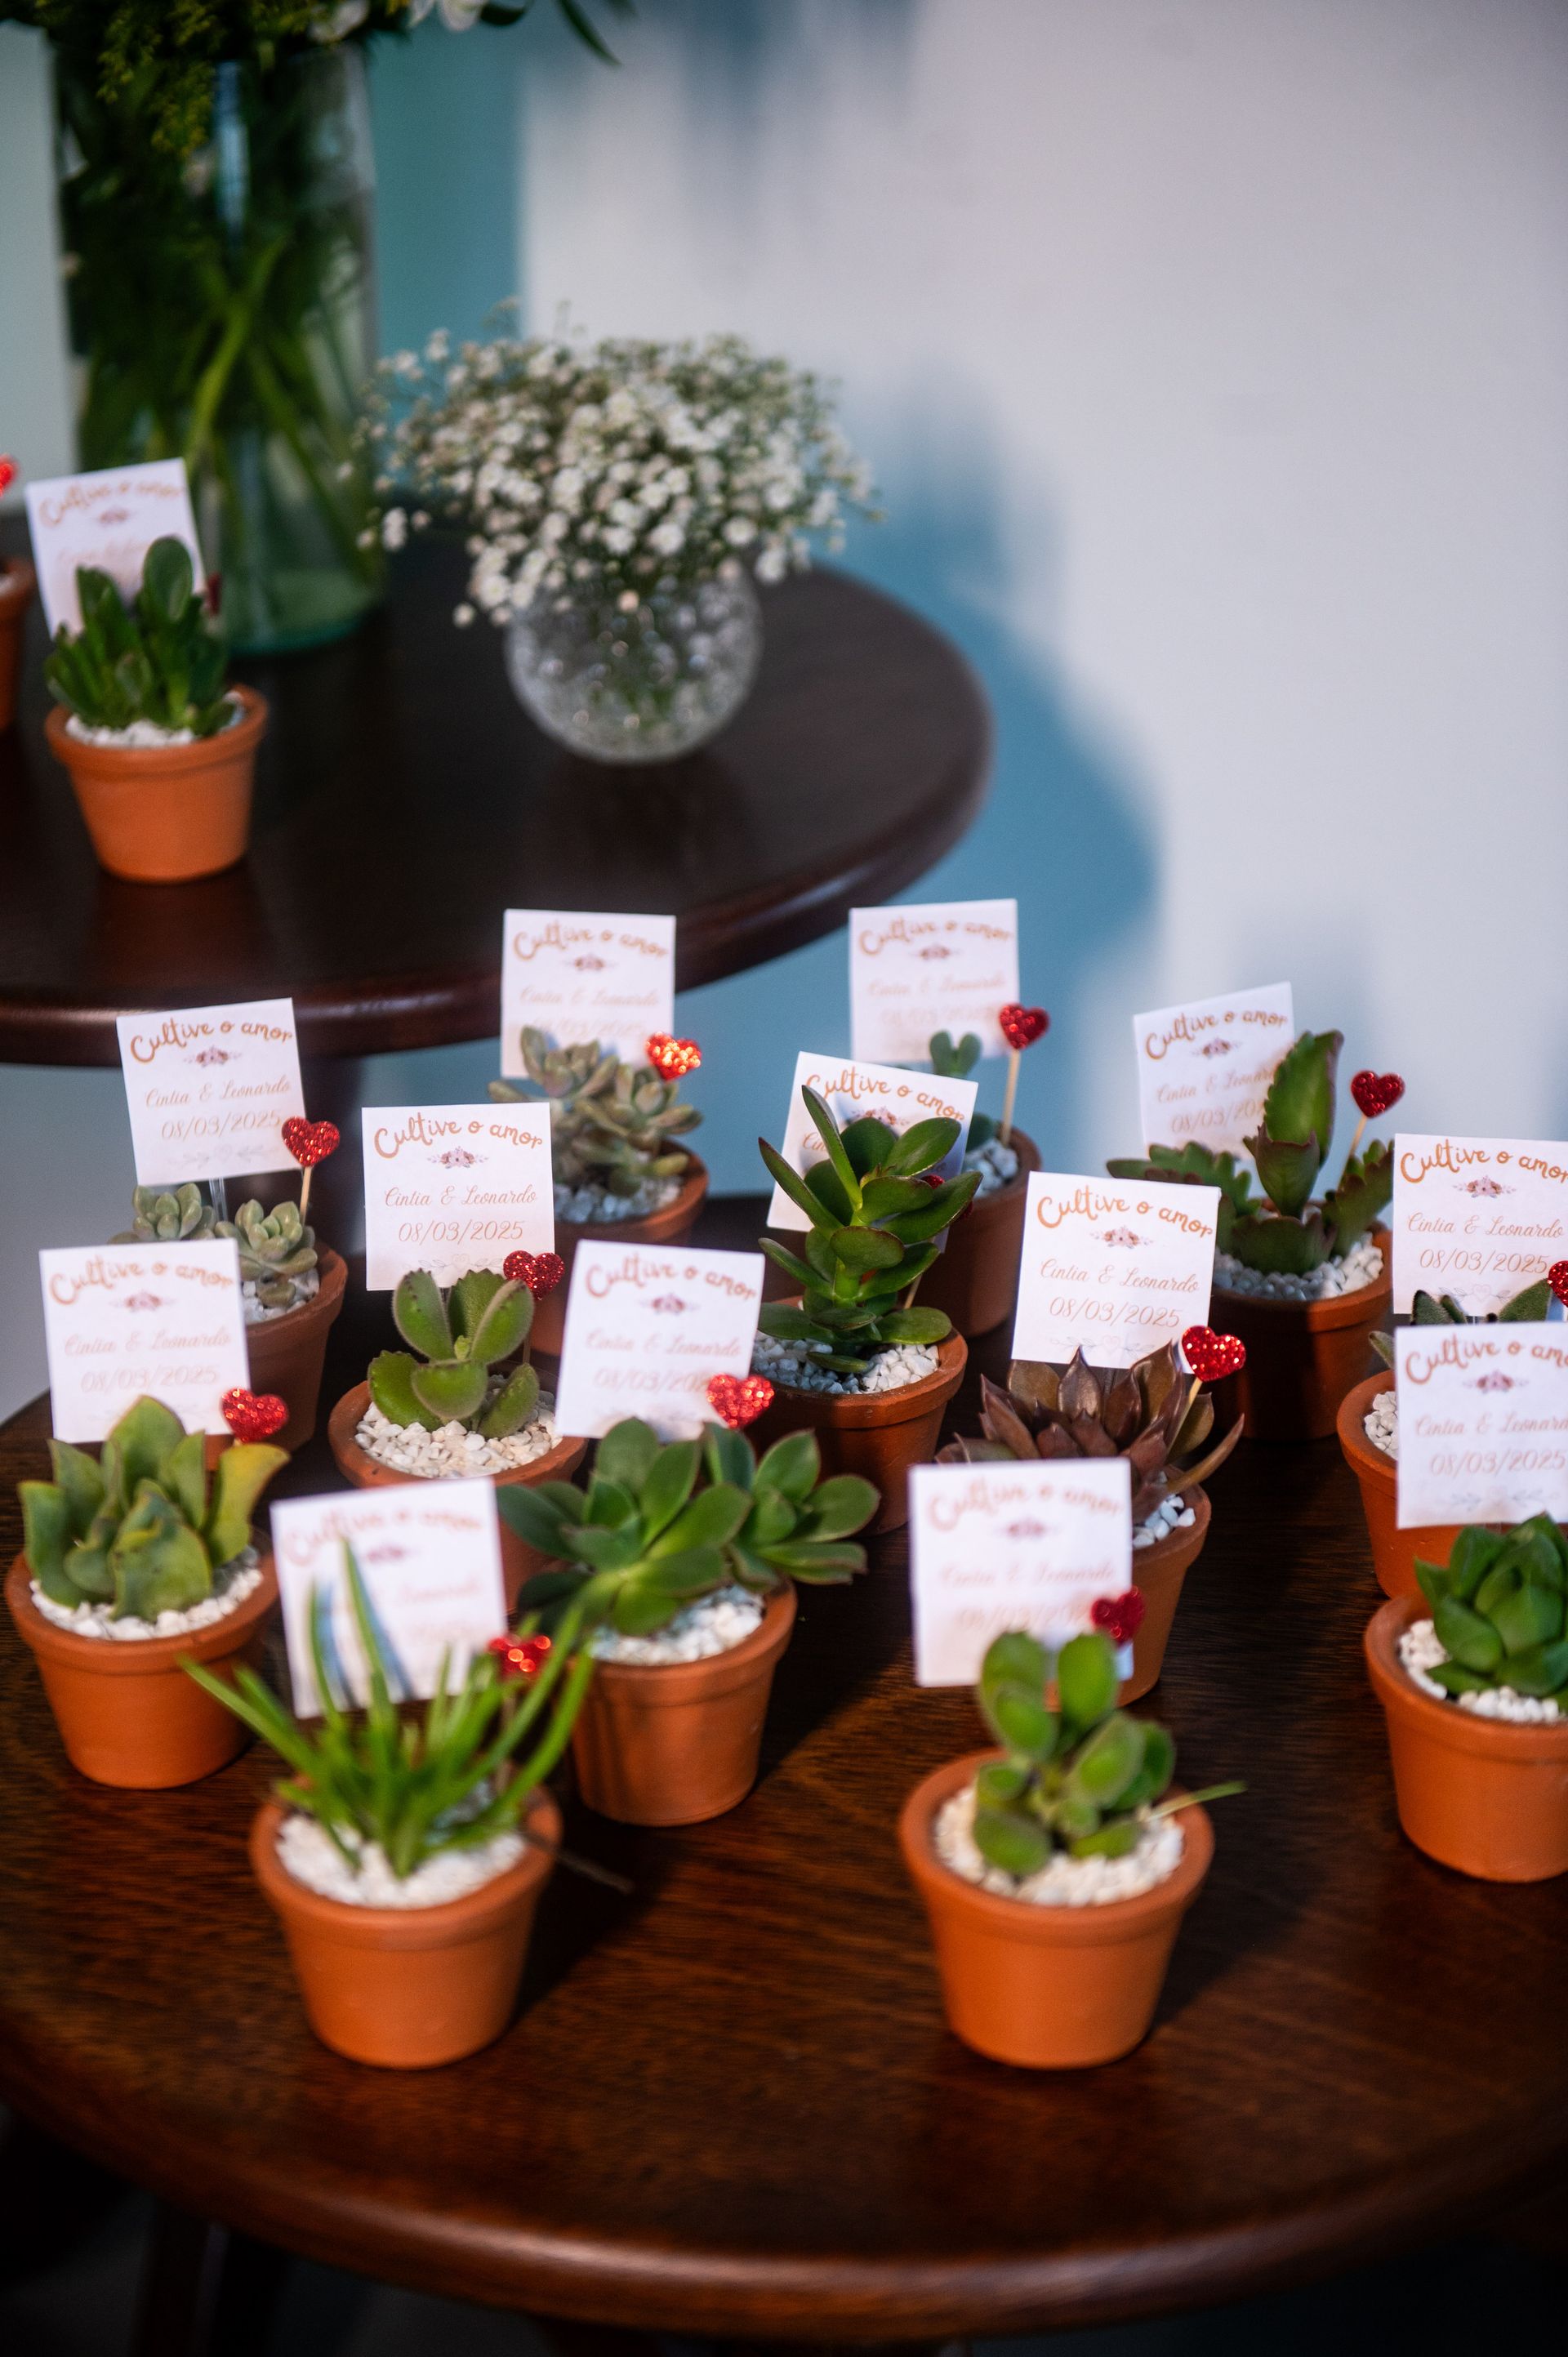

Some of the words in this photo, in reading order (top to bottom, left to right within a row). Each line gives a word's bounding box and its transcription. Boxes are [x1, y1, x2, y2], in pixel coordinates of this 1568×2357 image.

[131, 1018, 214, 1063] Cultive
[220, 1022, 234, 1032] o
[241, 1022, 292, 1041] amor
[1146, 1013, 1217, 1060] Cultive
[1224, 1011, 1236, 1023] o
[1242, 1011, 1288, 1028] amor
[199, 1084, 212, 1102] &
[220, 1075, 290, 1099] Leonardo
[898, 1085, 913, 1098] o
[916, 1093, 965, 1121] amor
[162, 1111, 282, 1141] 08/03/2025
[374, 1112, 461, 1158] Cultive
[468, 1121, 483, 1134] o
[490, 1124, 542, 1149] amor
[1401, 1139, 1490, 1183] Cultive
[1496, 1151, 1513, 1164] o
[385, 1187, 431, 1206] Cintia
[440, 1186, 457, 1205] &
[461, 1184, 537, 1205] Leonardo
[1037, 1186, 1129, 1228] Cultive
[1137, 1201, 1153, 1214] o
[1159, 1205, 1213, 1238] amor
[399, 1219, 524, 1245] 08/03/2025
[1408, 1212, 1455, 1233] Cintia
[1464, 1215, 1479, 1234] &
[1486, 1215, 1565, 1238] Leonardo
[1041, 1259, 1089, 1281] Cintia
[1098, 1265, 1114, 1283] &
[1120, 1267, 1199, 1294] Leonardo
[1419, 1248, 1548, 1274] 08/03/2025
[50, 1254, 143, 1306] Cultive
[151, 1261, 168, 1274] o
[1049, 1296, 1183, 1327] 08/03/2025
[1405, 1334, 1499, 1384] Cultive
[1508, 1341, 1522, 1356] o
